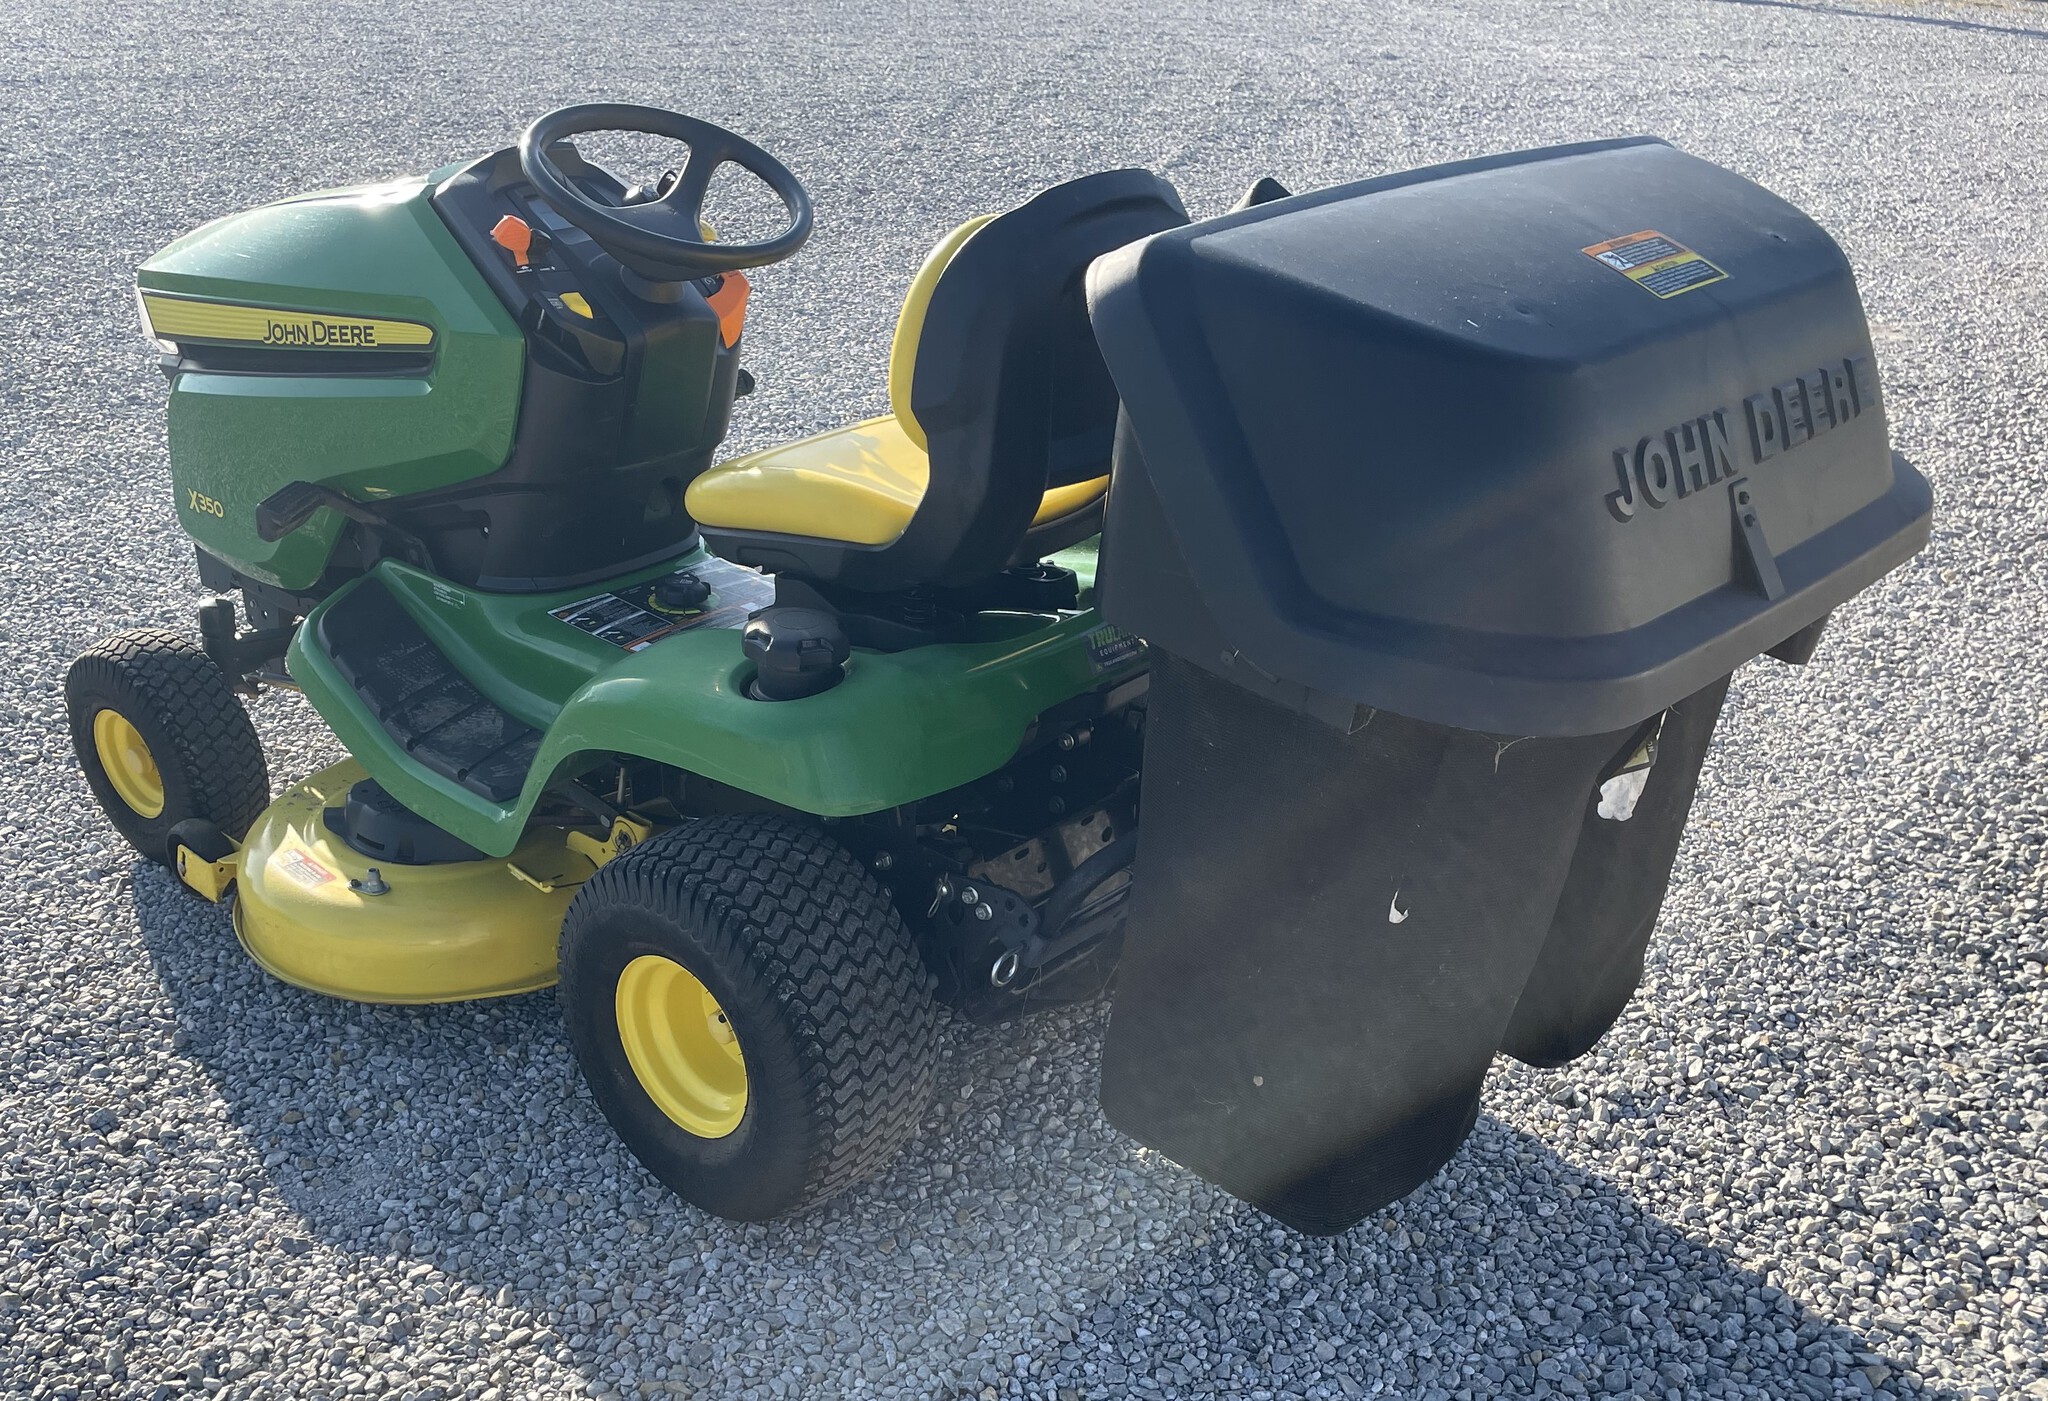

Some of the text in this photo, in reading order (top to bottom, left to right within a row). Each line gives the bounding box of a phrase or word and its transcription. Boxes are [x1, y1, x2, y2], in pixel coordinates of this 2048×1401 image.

[263, 319, 377, 345] JOHN DEERE
[1604, 355, 1876, 524] JOHN DEERE
[187, 487, 224, 519] X350
